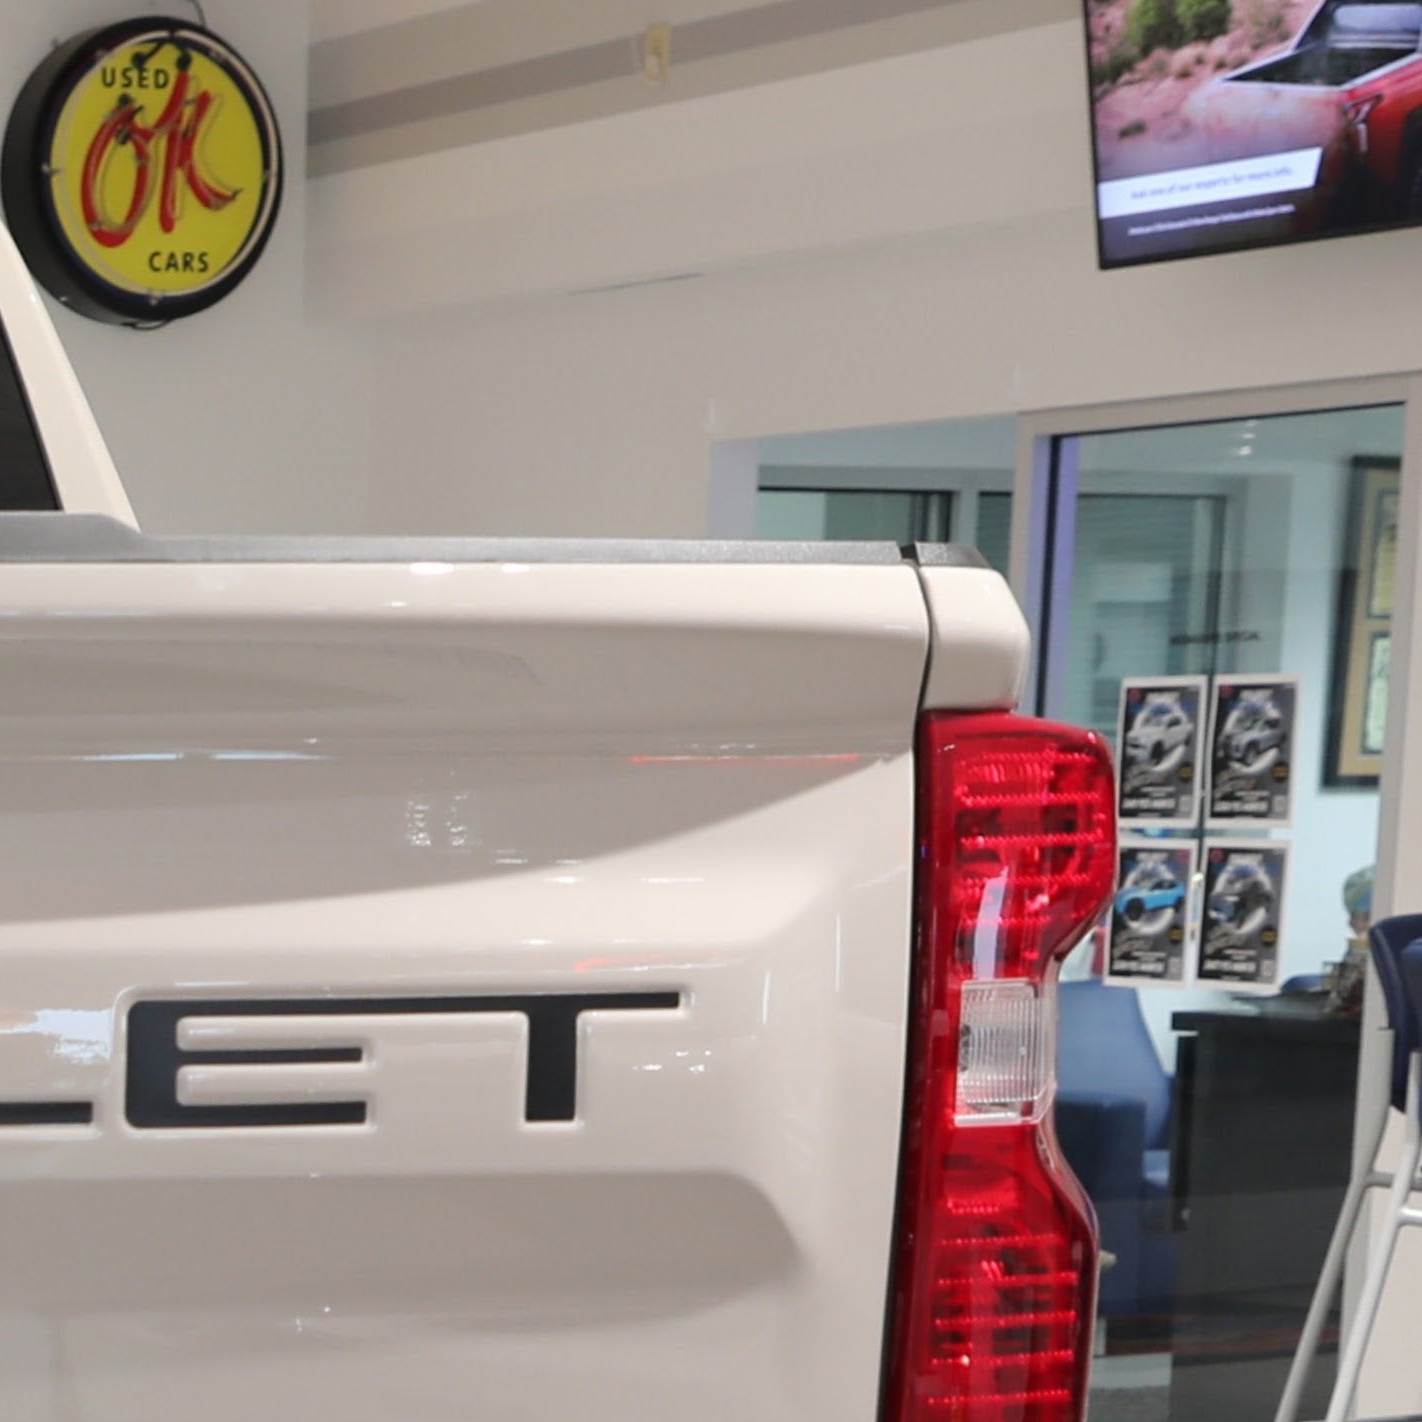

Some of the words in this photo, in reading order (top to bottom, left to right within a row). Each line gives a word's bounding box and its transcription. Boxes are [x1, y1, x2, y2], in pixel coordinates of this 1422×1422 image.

[101, 67, 170, 89] USED
[81, 68, 241, 247] OK
[148, 251, 209, 273] CARS
